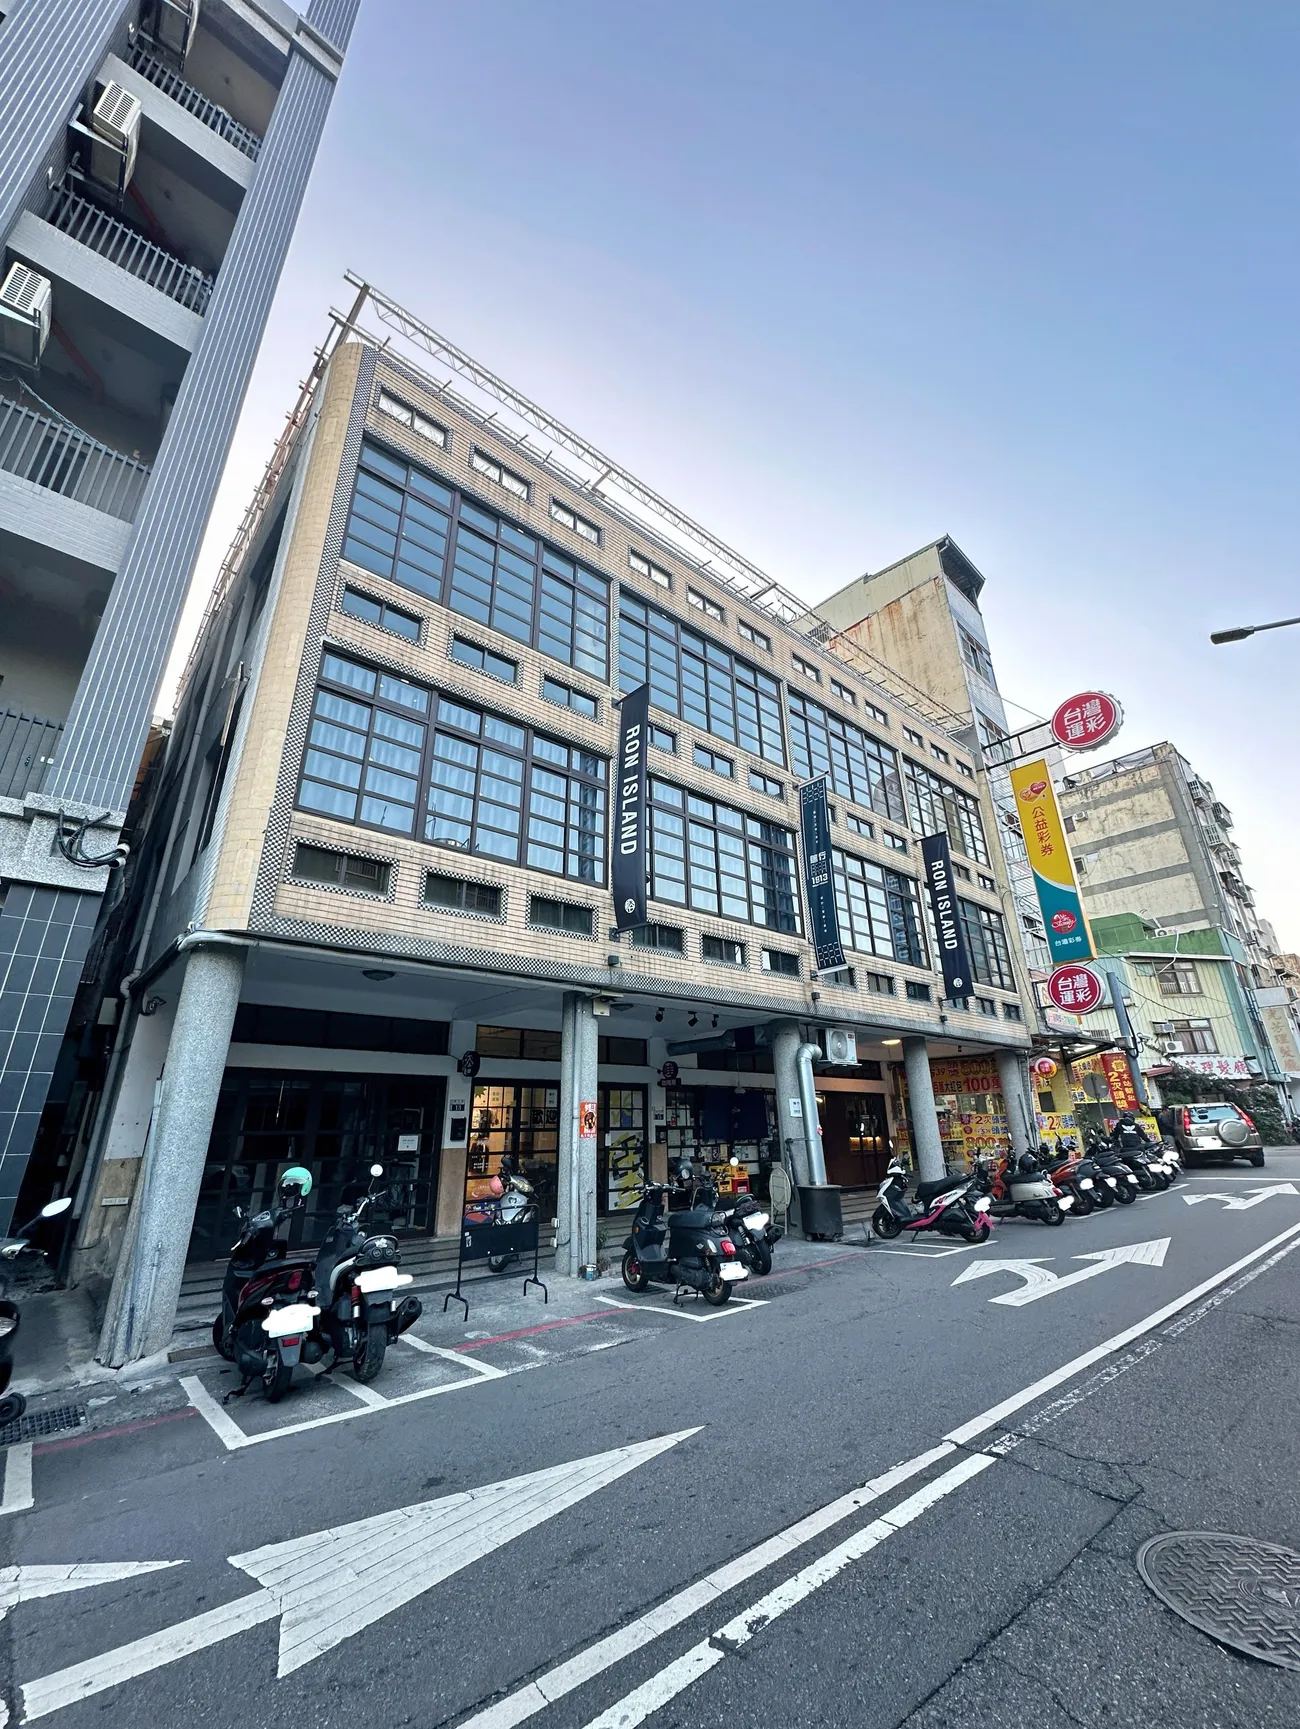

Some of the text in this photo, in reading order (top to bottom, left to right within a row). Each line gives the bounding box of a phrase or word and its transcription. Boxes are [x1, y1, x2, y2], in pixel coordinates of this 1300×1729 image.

[1064, 698, 1102, 726] 台灣
[1065, 713, 1107, 741] 運彩
[620, 724, 640, 855] RON ISLAND
[1032, 806, 1054, 857] 公益彩券
[931, 859, 958, 950] RON ISLAND
[1057, 973, 1089, 992] 台灣
[1059, 989, 1093, 1006] 運彩
